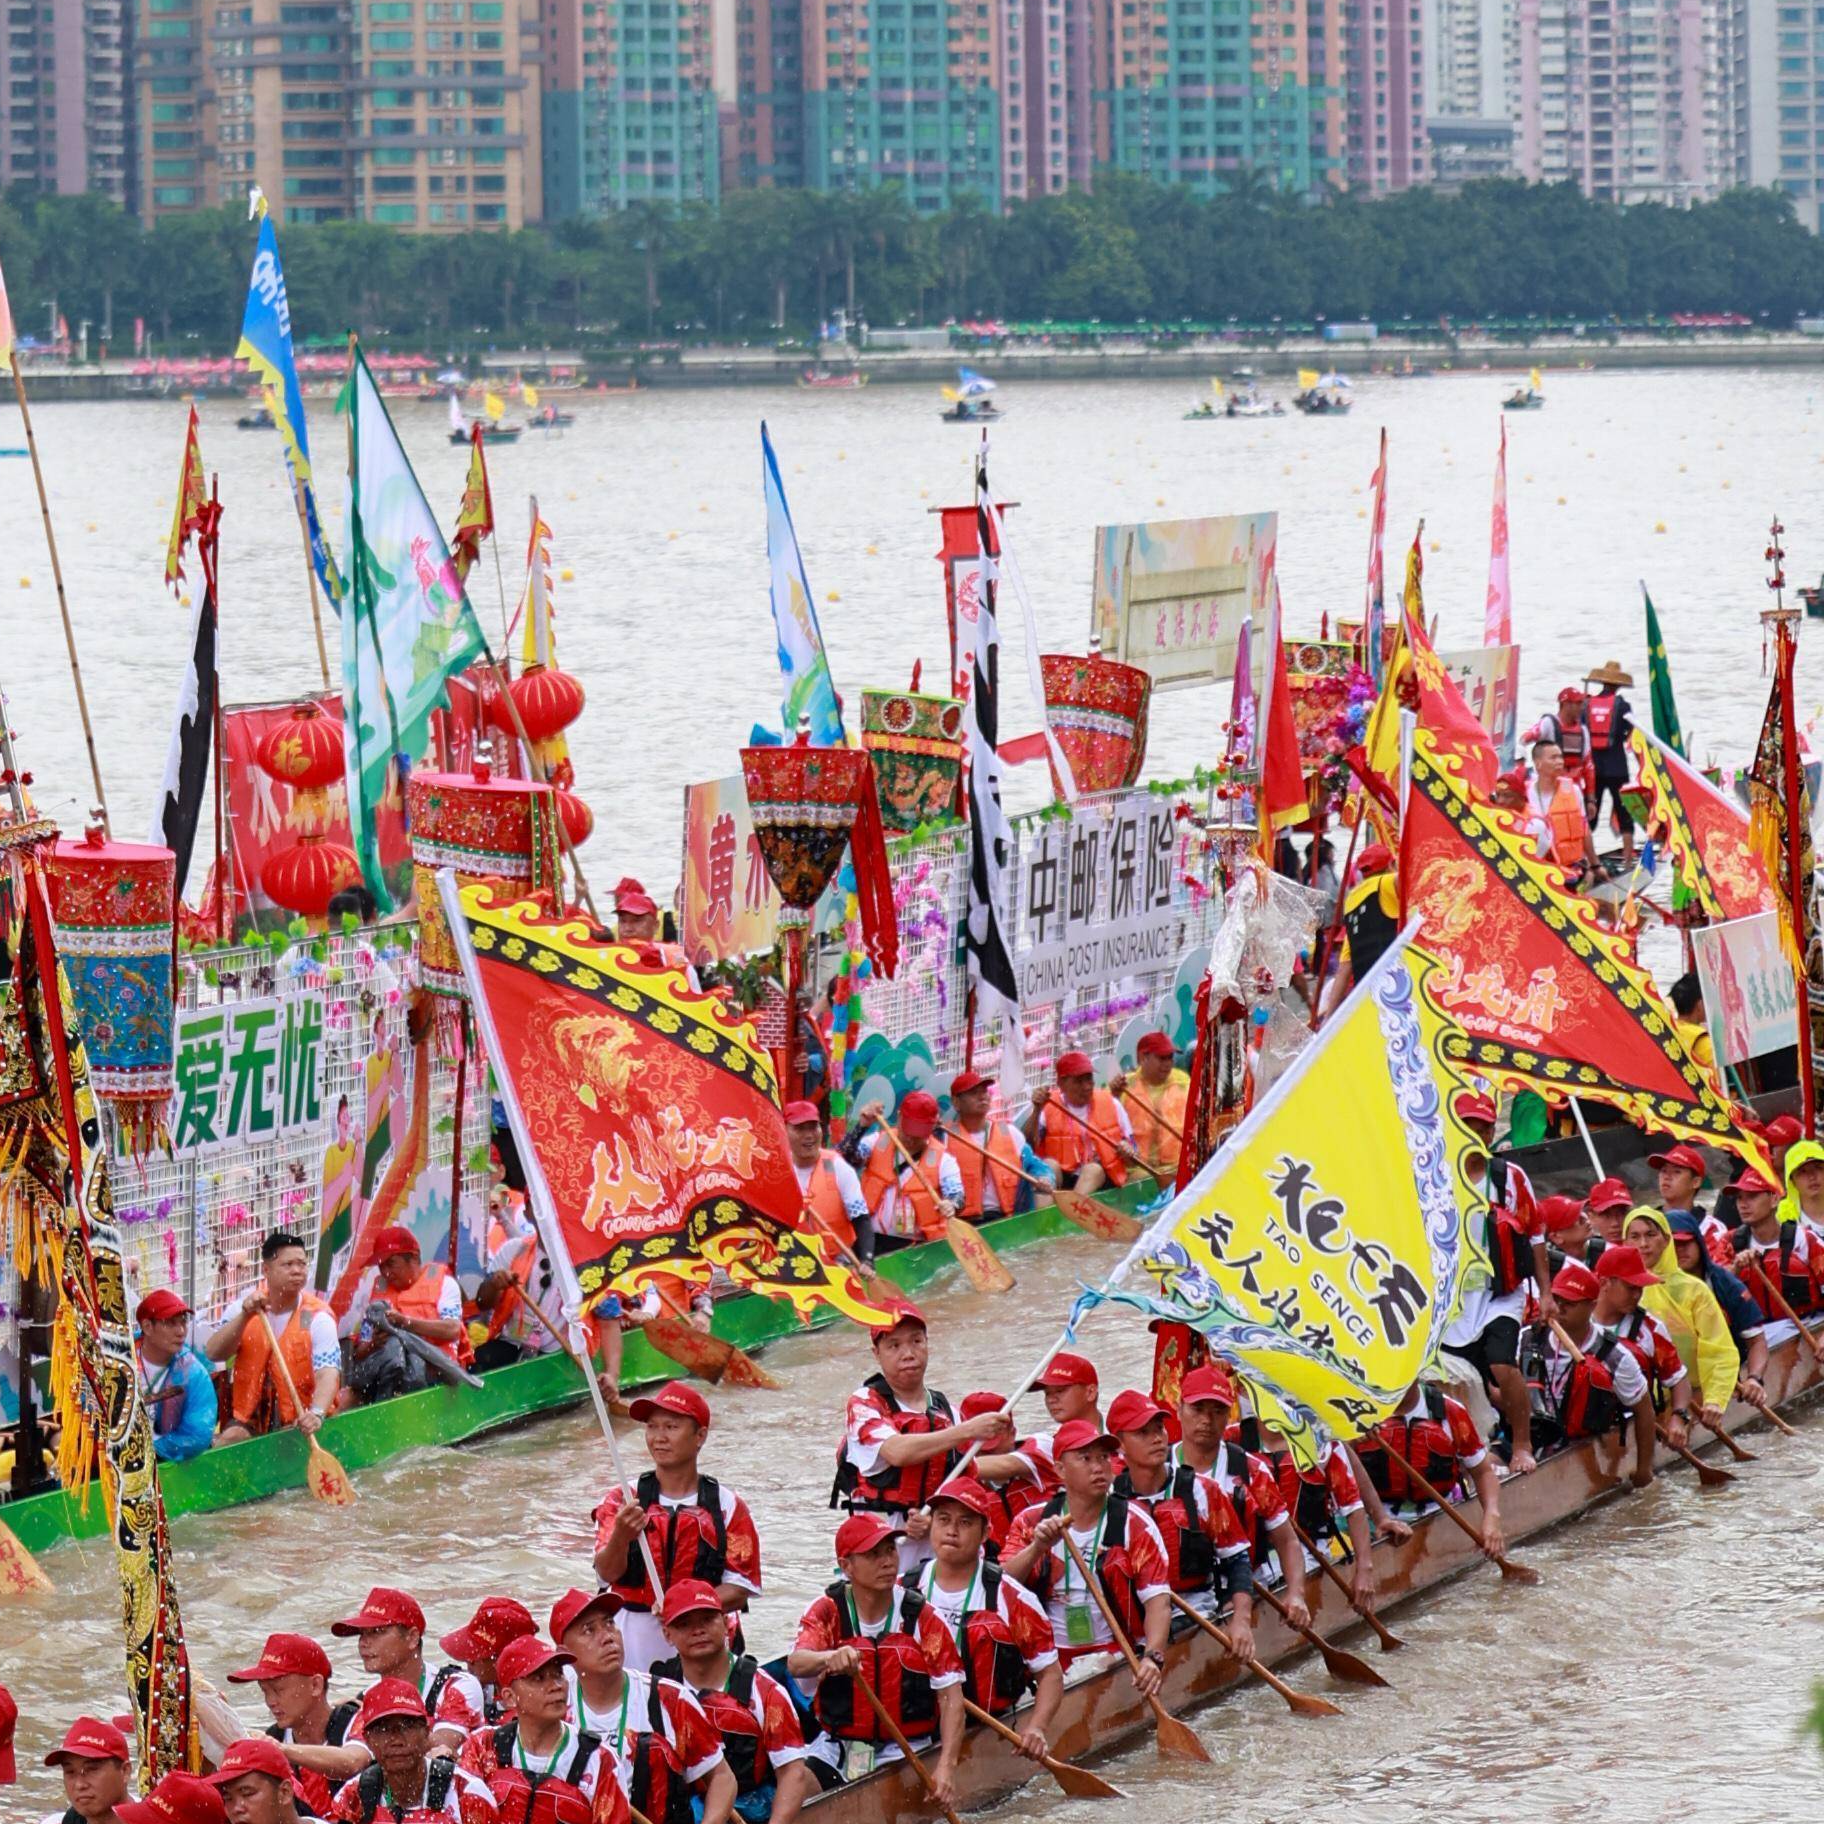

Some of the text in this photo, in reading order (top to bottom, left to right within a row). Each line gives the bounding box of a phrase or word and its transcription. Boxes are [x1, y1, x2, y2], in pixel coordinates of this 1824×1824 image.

[1029, 808, 1174, 943] 中邮保险
[1027, 925, 1170, 995] CHINA POST INSURANCE
[177, 998, 323, 1148] 爱无忧
[1265, 1217, 1301, 1264] TAO
[1310, 1273, 1374, 1346] SENCE
